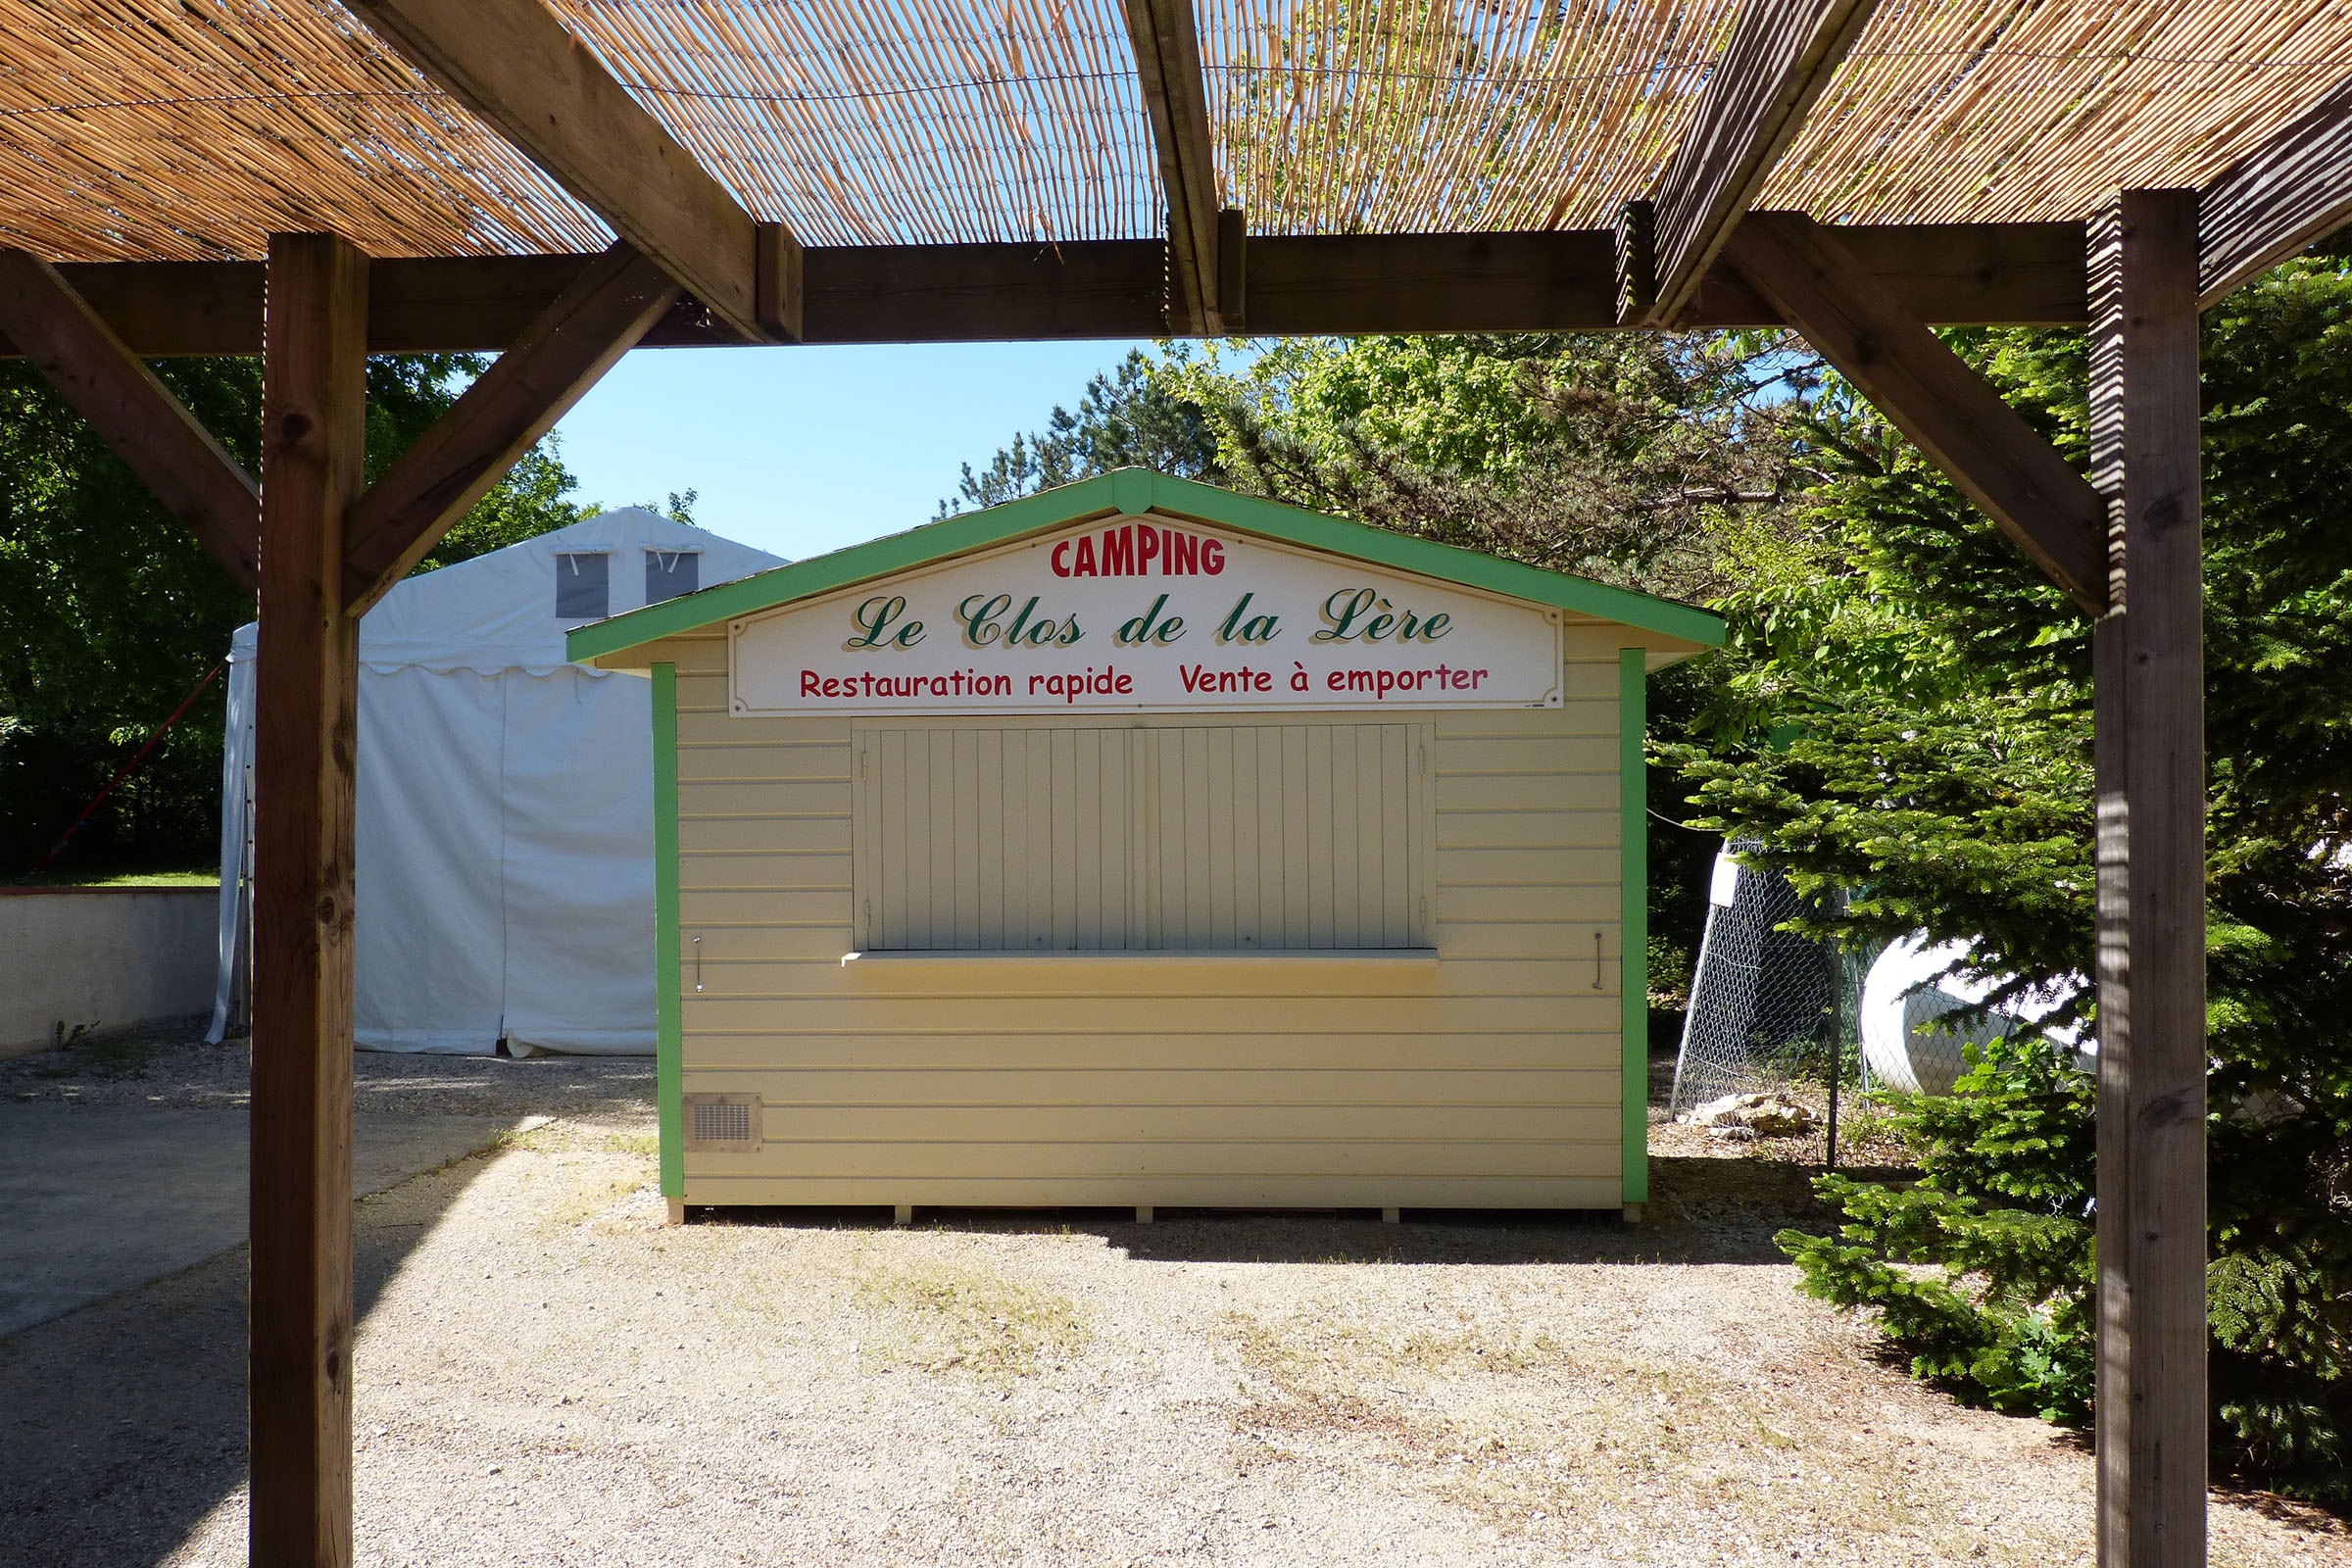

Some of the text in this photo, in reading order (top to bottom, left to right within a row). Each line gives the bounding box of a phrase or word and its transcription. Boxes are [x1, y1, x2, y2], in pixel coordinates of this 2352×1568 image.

[1052, 523, 1225, 578] CAMPING
[847, 587, 1453, 648] Le Clos de la Lère
[801, 662, 1488, 704] Restauration rapide Vente à emporter
